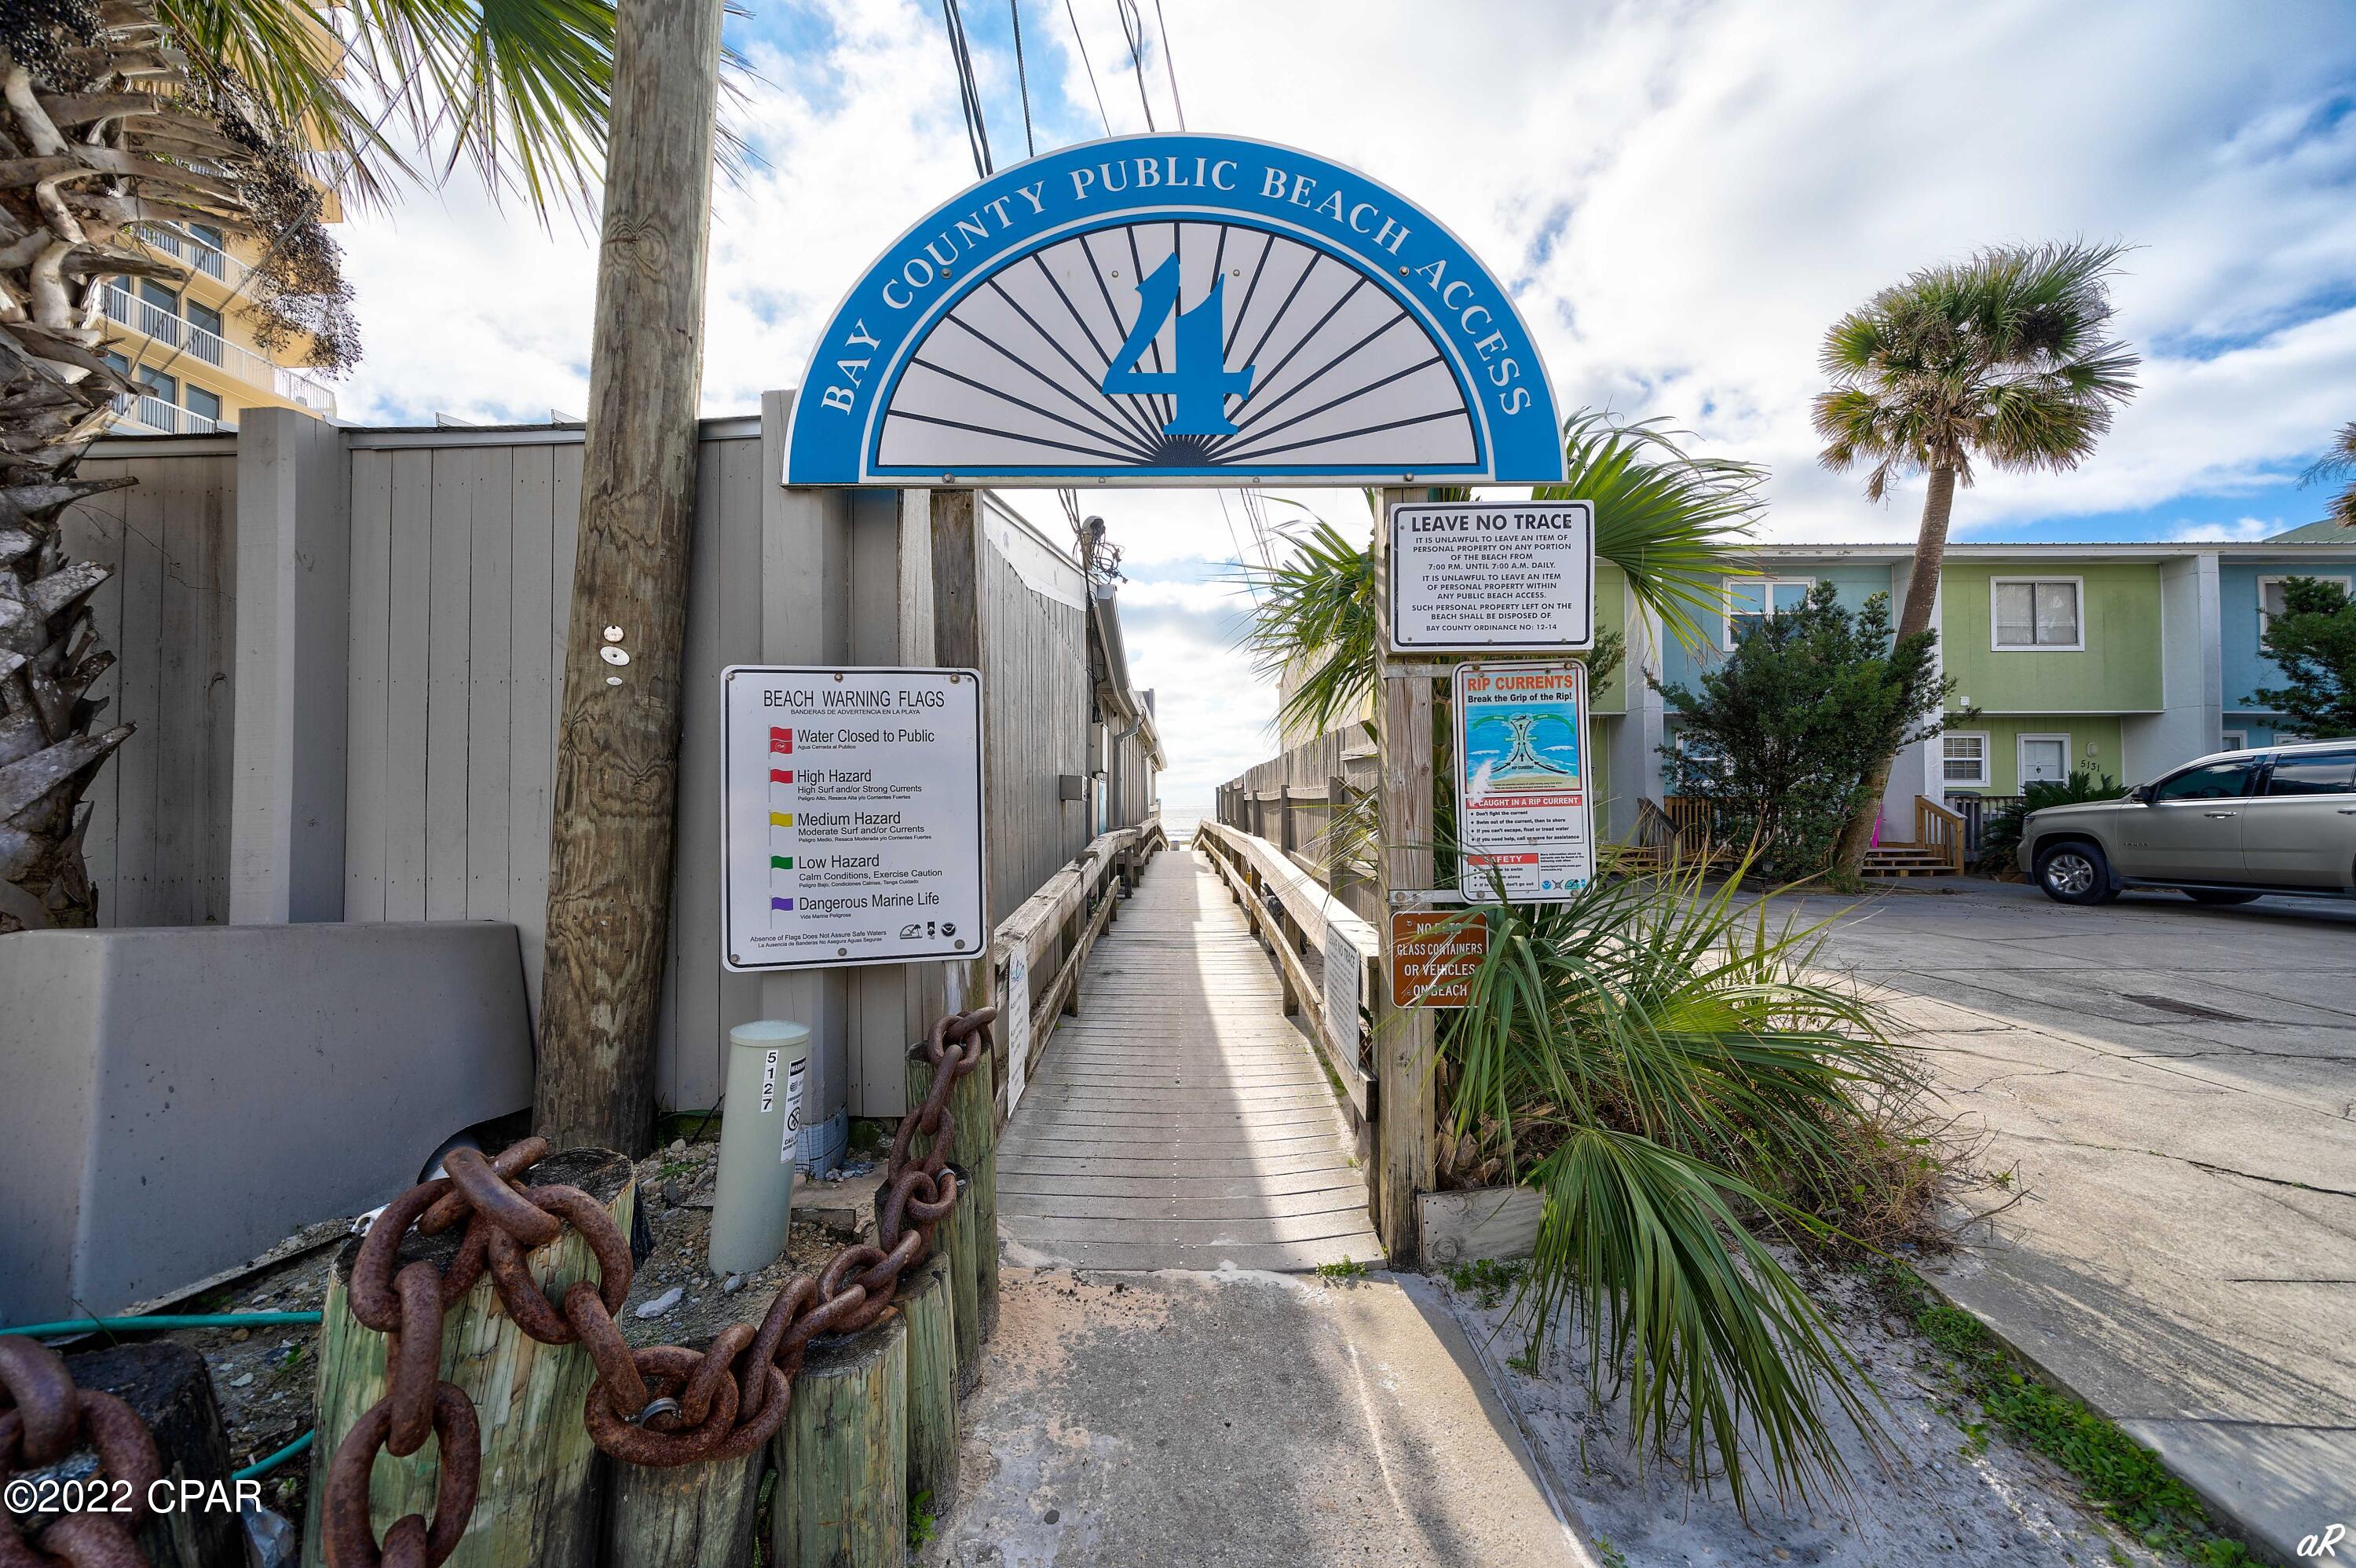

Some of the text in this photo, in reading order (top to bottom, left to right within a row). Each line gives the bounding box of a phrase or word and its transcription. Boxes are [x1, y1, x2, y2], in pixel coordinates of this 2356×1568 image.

[821, 157, 1532, 417] BAY COUNTY PUBLIC BEACH ACCESS
[1101, 251, 1256, 436] 4
[1412, 514, 1571, 532] LEAVE NO TRACE
[1468, 675, 1572, 691] RIP CURRENTS
[764, 690, 944, 707] BEACH WARNING FLAGS
[1510, 693, 1527, 703] Grip
[1556, 692, 1571, 701] Rip!
[797, 729, 934, 742] Water Closed to Public
[2081, 760, 2100, 772] 5131
[798, 769, 871, 785] High Hazard
[798, 786, 815, 795] High
[862, 785, 887, 794] Strong
[798, 811, 900, 826] Medium Hazard
[799, 854, 879, 868] Low Hazard
[799, 892, 938, 912] Dangerous Marine Life
[1417, 923, 1431, 934] NO
[1397, 944, 1425, 955] GLASS
[1404, 964, 1418, 976] OR
[1414, 985, 1428, 996] ON
